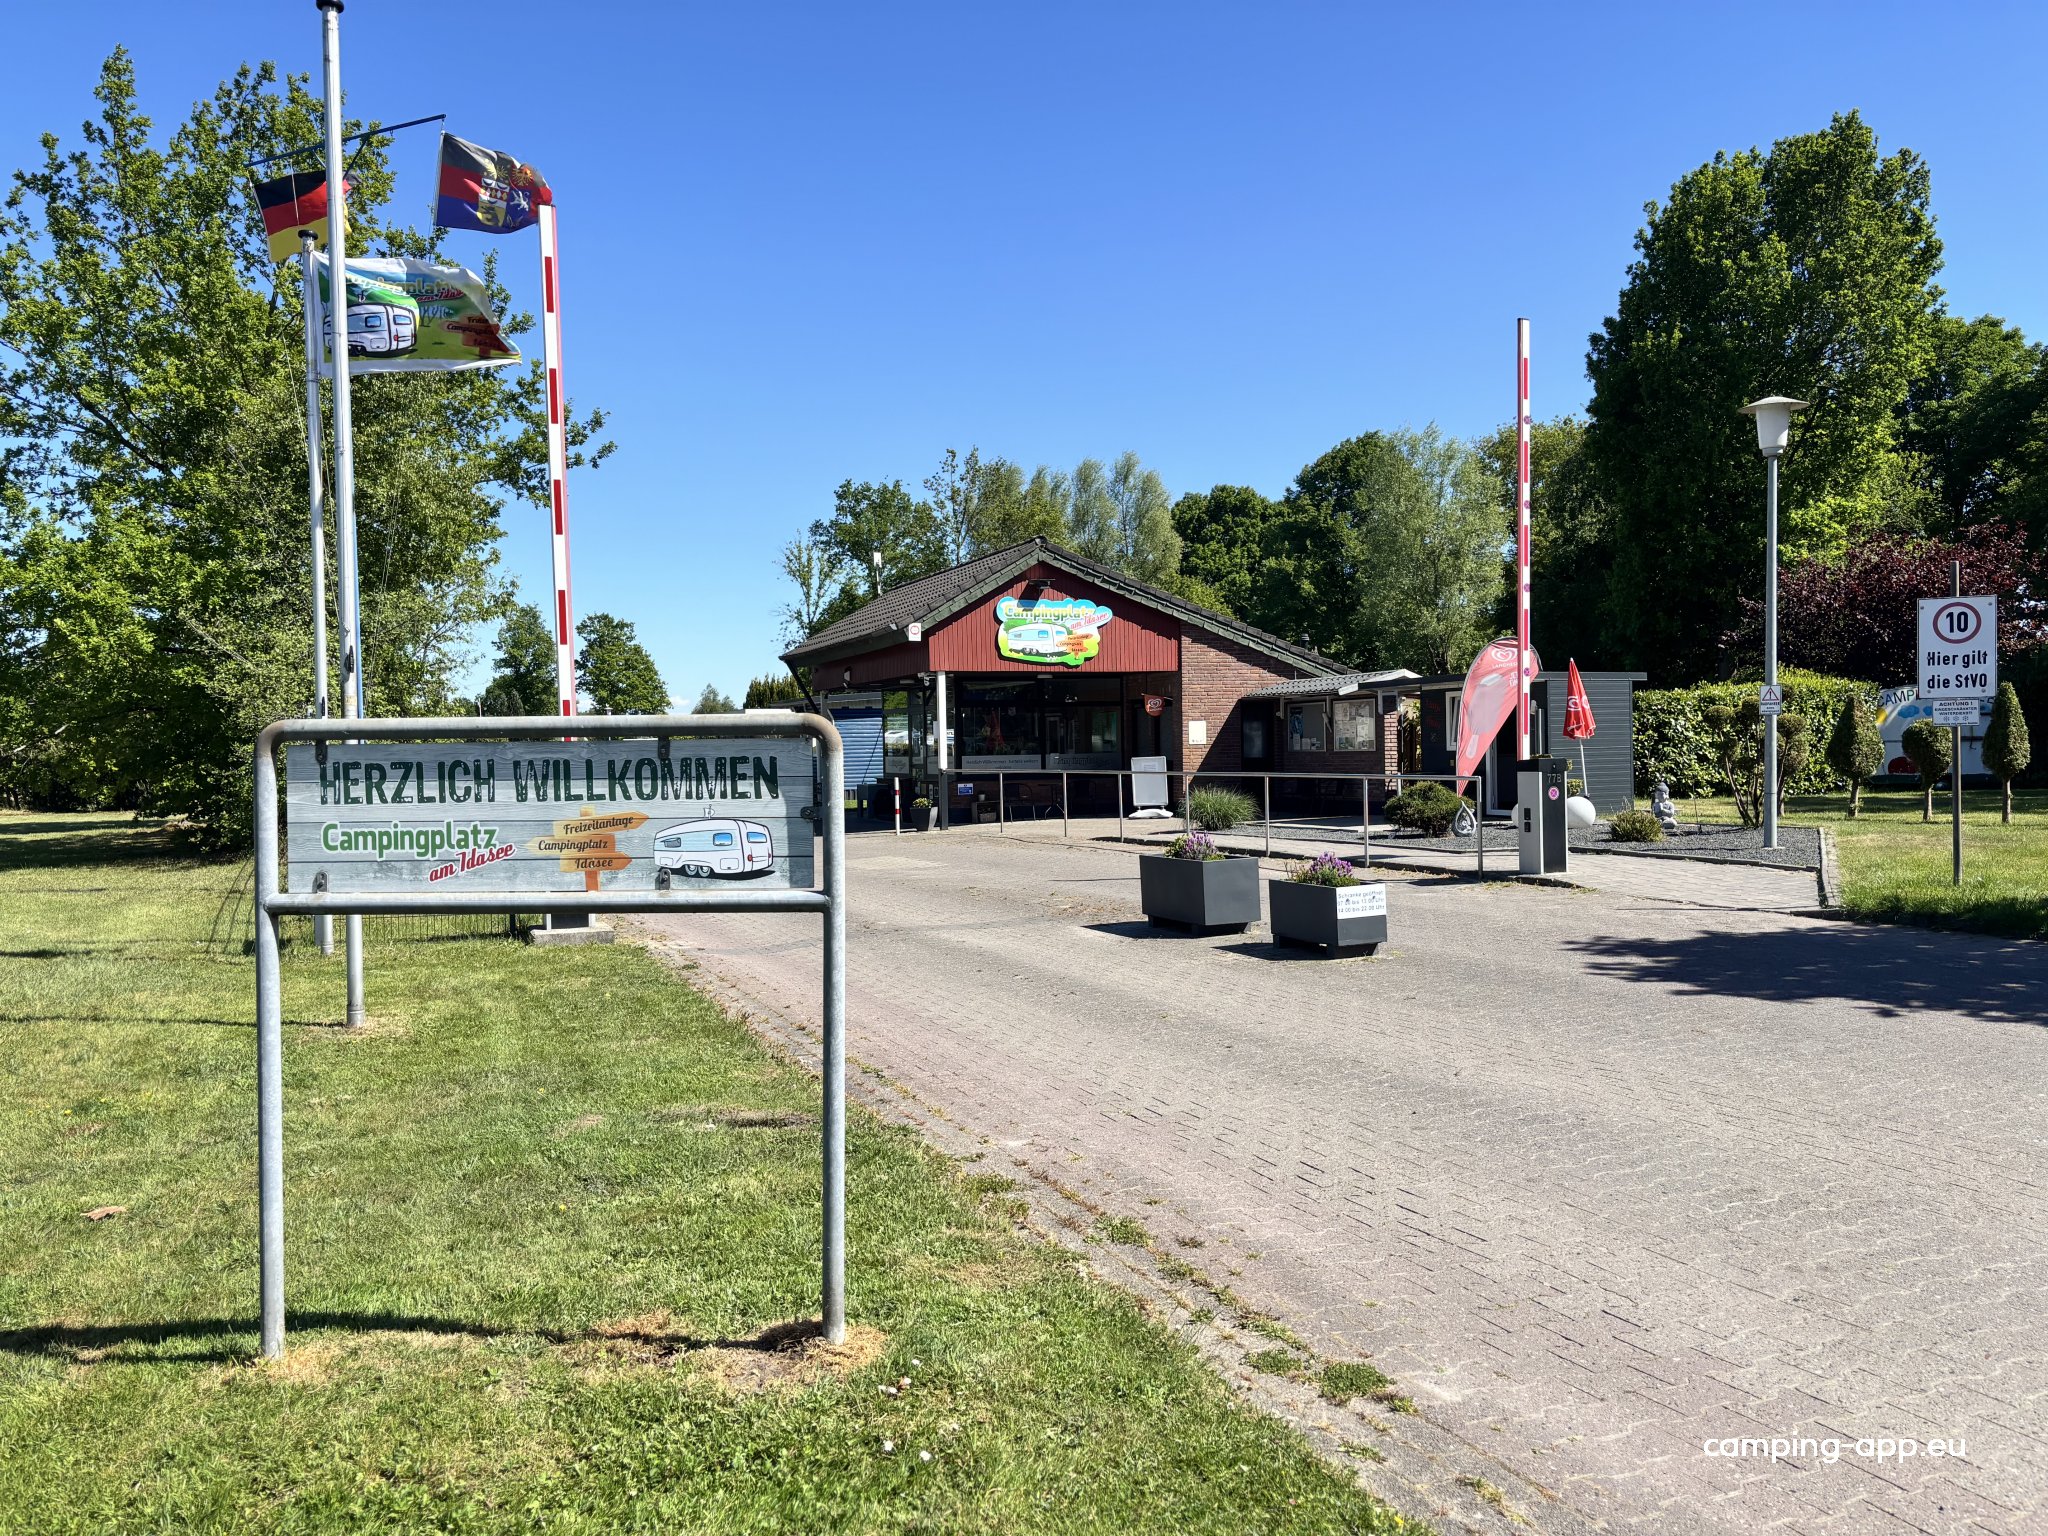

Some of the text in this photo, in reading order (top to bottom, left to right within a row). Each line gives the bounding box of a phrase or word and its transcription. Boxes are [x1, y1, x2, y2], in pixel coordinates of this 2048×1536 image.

[1946, 611, 1968, 633] 10
[1927, 650, 1988, 668] Hier gilt
[1927, 673, 1987, 689] die StVO
[319, 755, 780, 805] HERZLICH WILLKOMMEN
[563, 816, 634, 835] Freizeitanlage
[322, 820, 498, 859] Campingplatz
[538, 839, 608, 853] Campingplatz
[429, 843, 515, 882] am Idasee
[574, 857, 613, 869] Idasee
